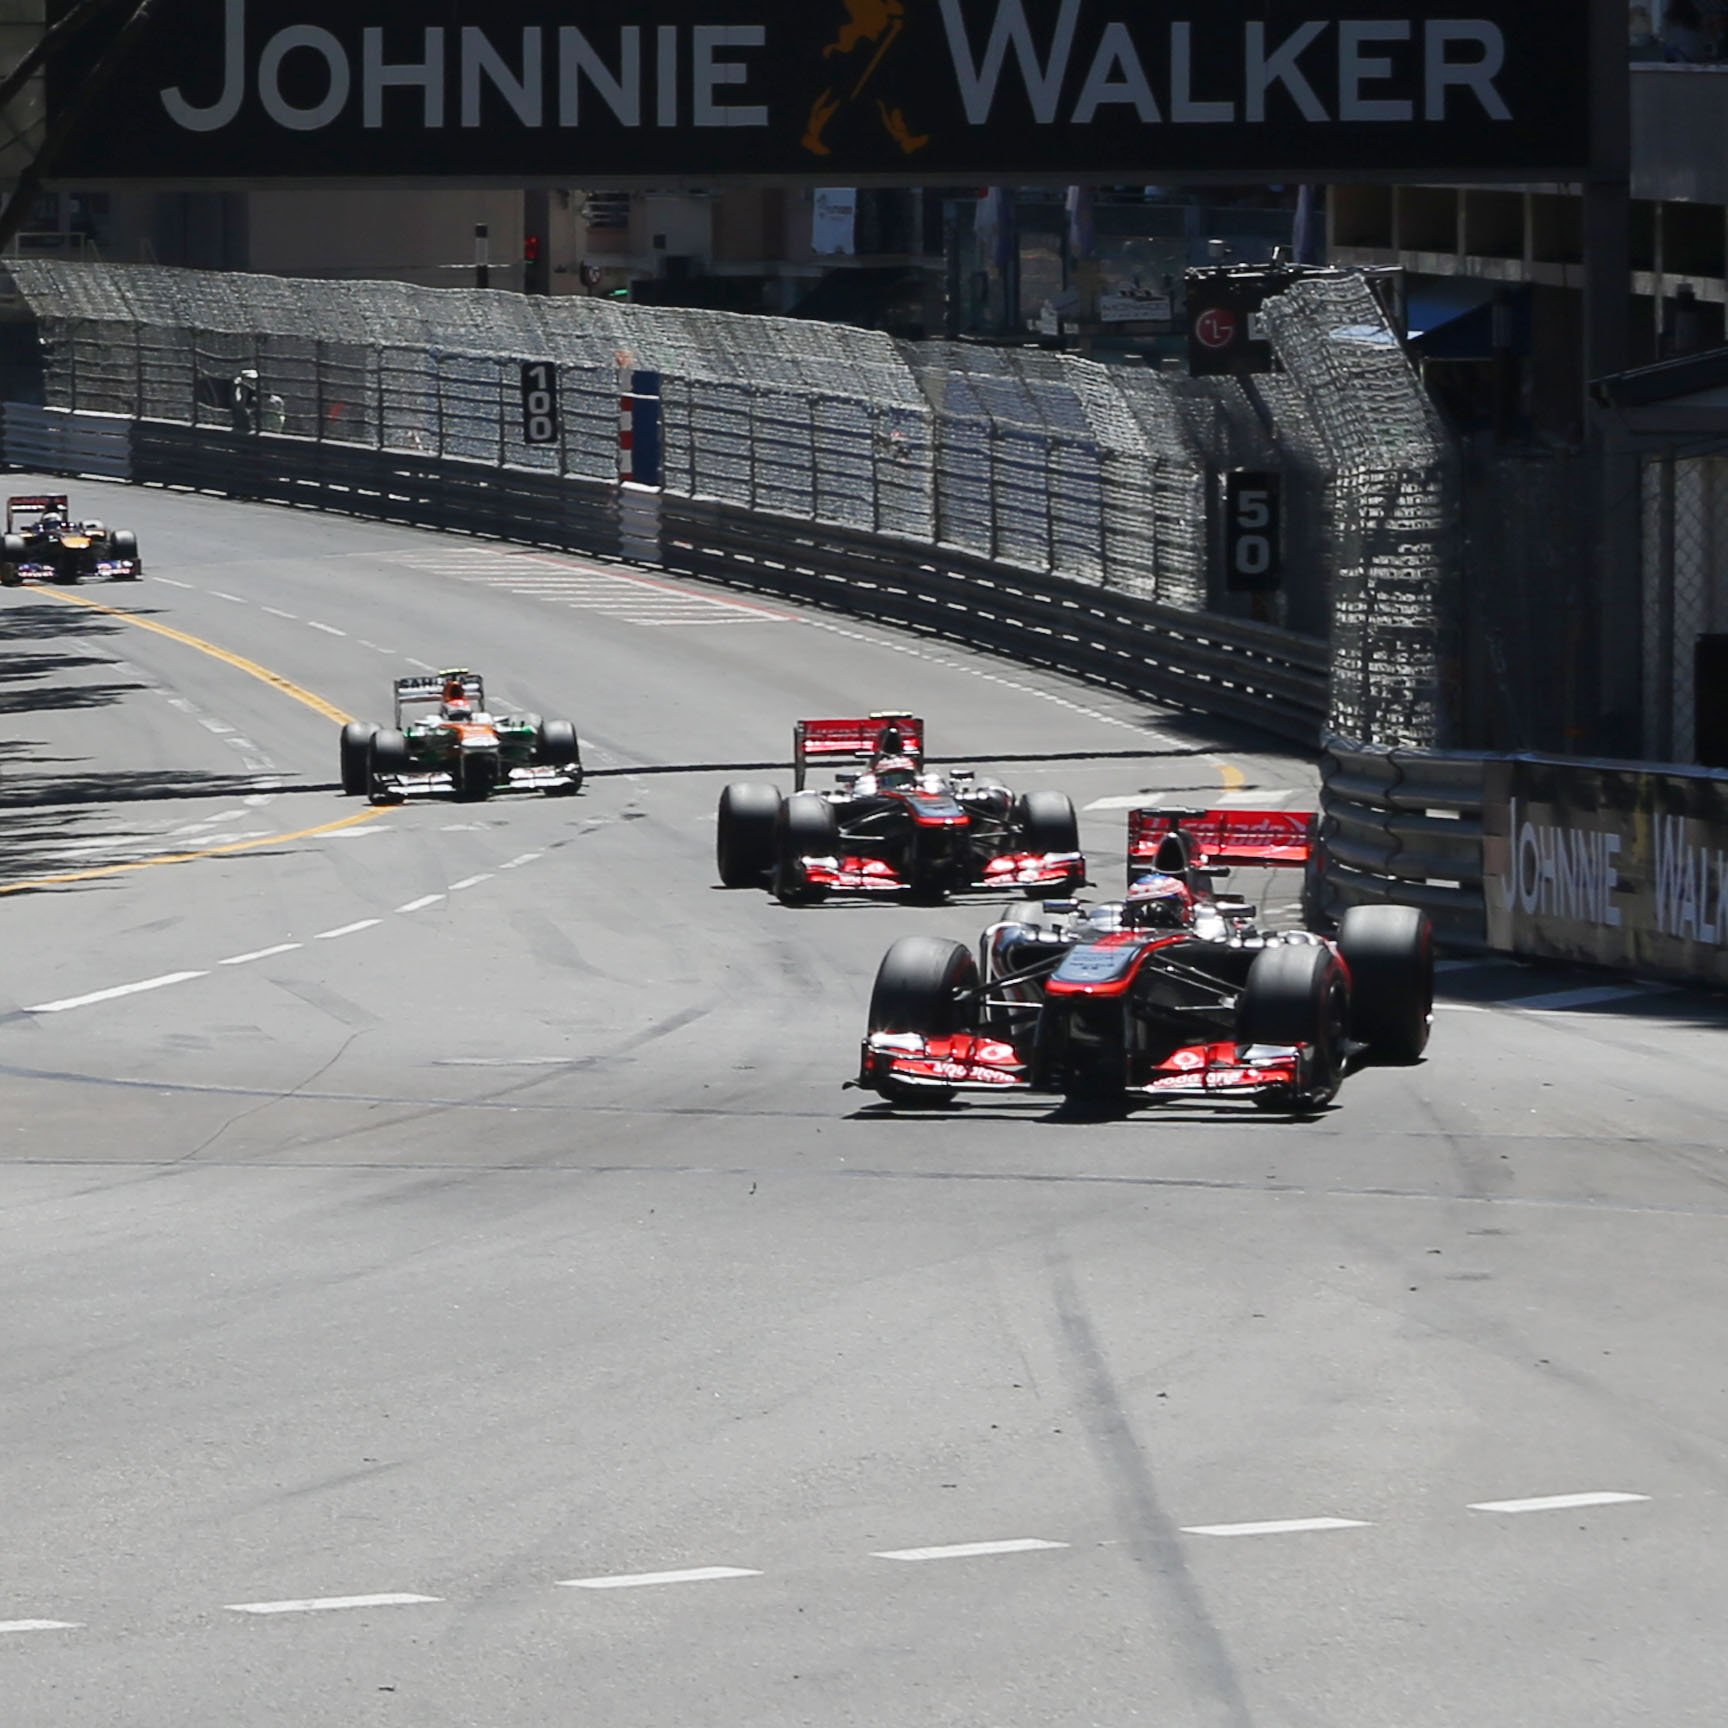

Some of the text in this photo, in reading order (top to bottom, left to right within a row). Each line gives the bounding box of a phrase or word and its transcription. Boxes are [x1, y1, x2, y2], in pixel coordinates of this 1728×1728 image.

[528, 365, 552, 440] 100
[1236, 491, 1270, 574] 50
[1501, 796, 1622, 927] JOHNNIE
